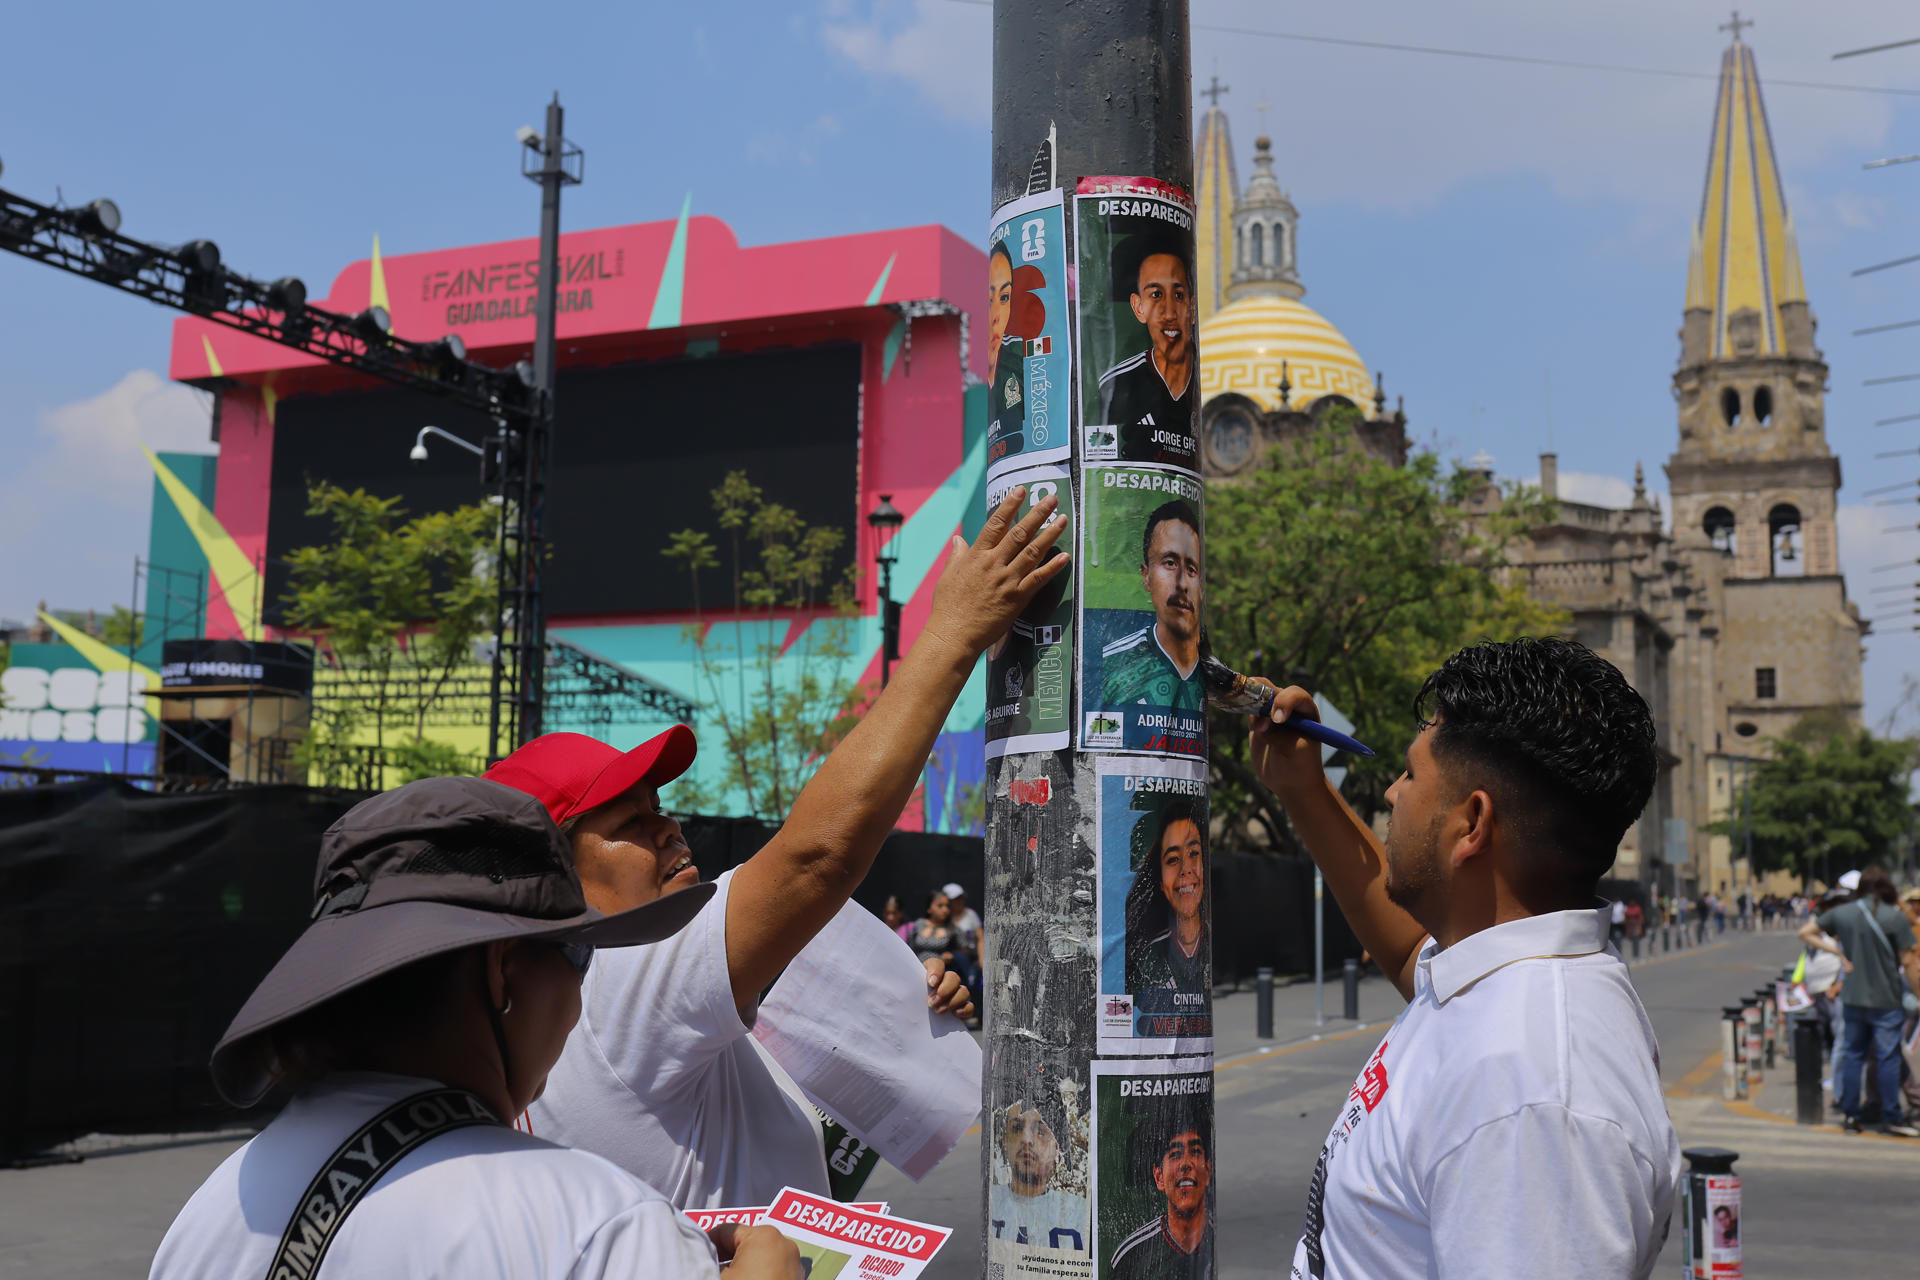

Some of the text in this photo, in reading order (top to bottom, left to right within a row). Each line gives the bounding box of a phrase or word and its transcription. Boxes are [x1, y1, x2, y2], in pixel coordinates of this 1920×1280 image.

[1098, 200, 1191, 231] DESAPARECIDO
[447, 289, 593, 325] GUADALAARA
[1030, 357, 1052, 446] MÉXICO
[1151, 430, 1181, 447] JORGE
[1104, 472, 1201, 499] DESAPARECID
[1034, 646, 1062, 720] MÉXICO
[992, 703, 1020, 719] AGUIRRE
[1137, 713, 1178, 730] ADRIÁN
[1143, 734, 1203, 755] JALISCO
[1124, 776, 1205, 799] DESAPARECID
[1173, 993, 1205, 1006] CINTHIA
[1120, 1076, 1211, 1097] DESAPARECIDO
[381, 1095, 499, 1146] LOLA
[783, 1200, 927, 1254] DESAPARECIDO
[858, 1254, 905, 1277] RICARDO
[1025, 1264, 1051, 1275] familia
[1052, 1269, 1078, 1278] espera
[1080, 1270, 1090, 1278] su
